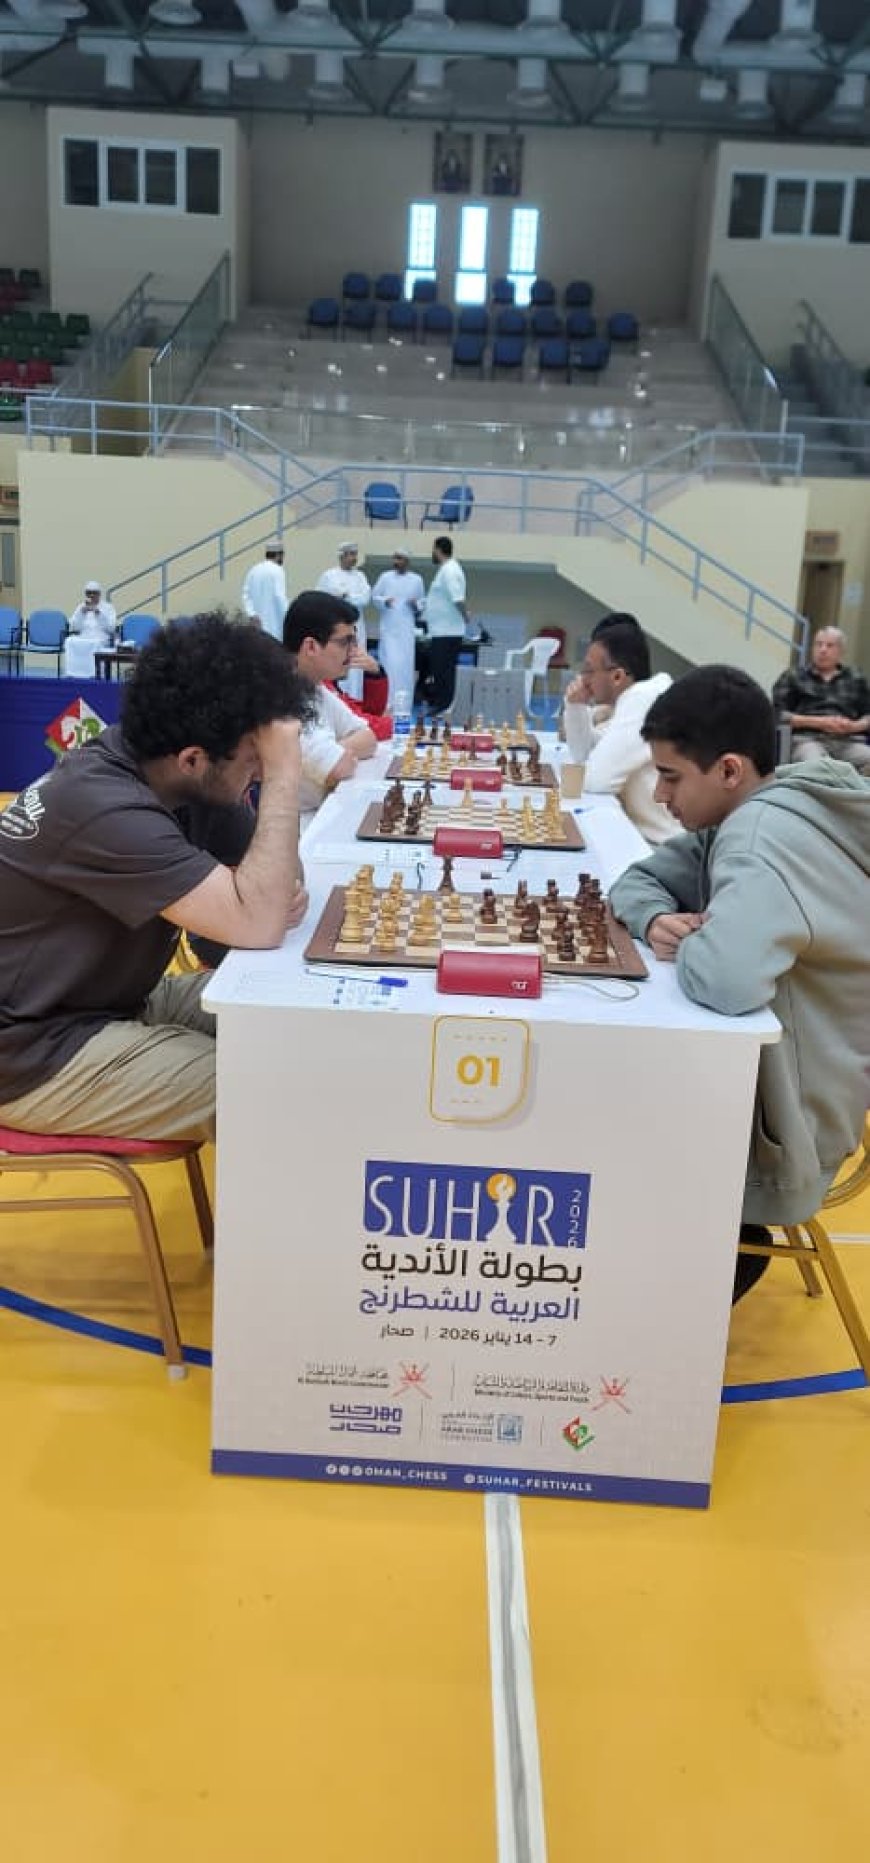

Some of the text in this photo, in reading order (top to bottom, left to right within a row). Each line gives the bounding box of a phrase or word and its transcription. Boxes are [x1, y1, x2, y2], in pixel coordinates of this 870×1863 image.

[457, 1055, 500, 1088] 01
[361, 1242, 582, 1292] بطولة الأندية
[359, 1285, 580, 1323] العربية للشطرنج
[380, 1324, 415, 1339] صحار
[439, 1327, 480, 1342] 2026
[514, 1333, 533, 1345] 14
[482, 1333, 512, 1347] يناير
